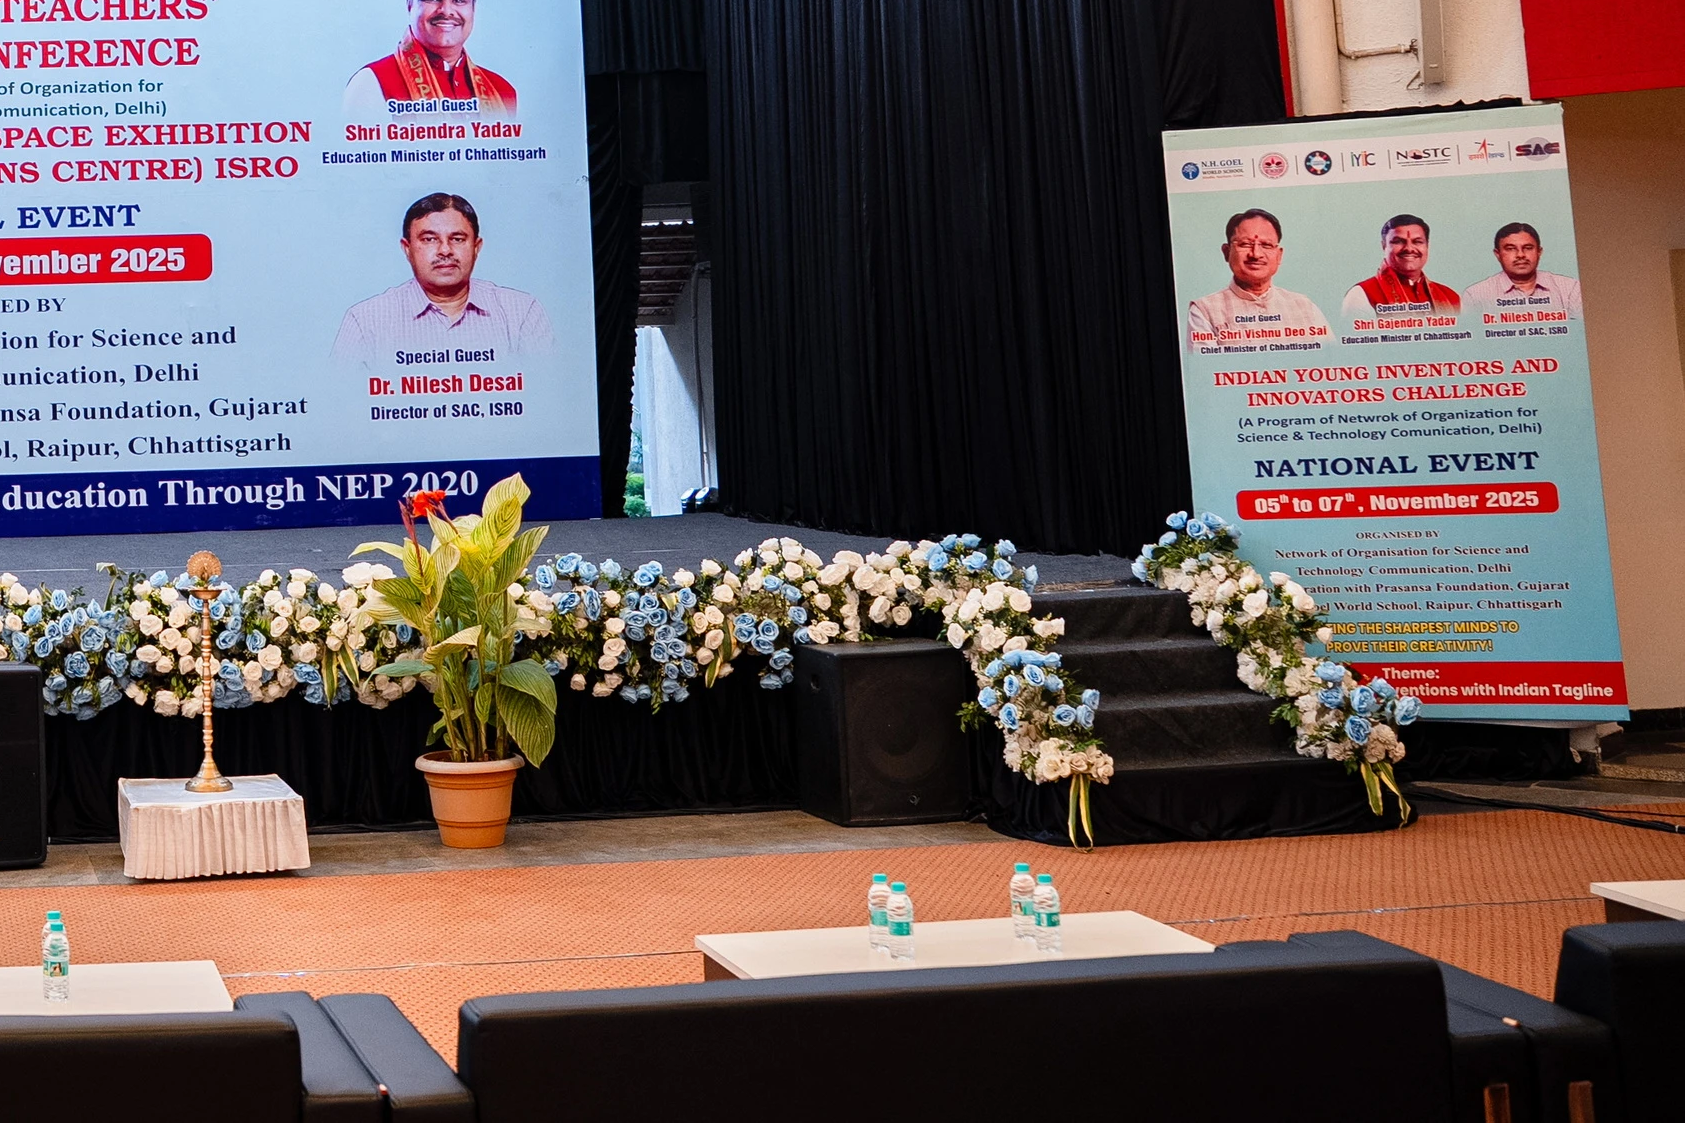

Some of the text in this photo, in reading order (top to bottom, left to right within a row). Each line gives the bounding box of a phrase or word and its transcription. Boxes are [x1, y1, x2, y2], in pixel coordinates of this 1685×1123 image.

[21, 80, 132, 97] Organization
[138, 79, 163, 92] for
[116, 101, 166, 116] Delhi)
[104, 122, 311, 146] EXHIBITION
[346, 122, 521, 141] Shri Gajendra Yadav
[52, 157, 202, 183] CENTRE)
[215, 156, 298, 178] ISRO
[17, 204, 140, 228] EVENT
[111, 247, 186, 273] 2025
[38, 298, 65, 312] BY
[48, 331, 83, 348] for
[92, 329, 182, 347] Science
[192, 327, 235, 344] and
[135, 363, 198, 382] Delhi
[1214, 359, 1558, 385] INDIAN YOUNG INVENTORS AND
[370, 373, 522, 395] Dr. Nilesh Desai
[1248, 383, 1526, 406] INNOVATORS CHALLENGE
[52, 400, 200, 420] Foundation,
[209, 398, 307, 420] Gujarat
[28, 439, 119, 461] Raipur,
[129, 433, 291, 457] Chhattisgarh
[1254, 452, 1539, 477] NATIONAL EVENT
[159, 477, 305, 510] Through
[316, 474, 393, 500] NEP
[402, 470, 478, 498] 2020
[1255, 495, 1289, 513] 05th
[1292, 498, 1312, 512] to
[1370, 493, 1479, 510] November
[1486, 491, 1539, 507] 2025
[1359, 622, 1519, 634] THE SHARPEST MINDS TO
[1326, 640, 1493, 652] PROVE THEIR CREATIVITY!
[1383, 668, 1440, 680] Theme:
[1461, 683, 1613, 700] with Indian Tagline
